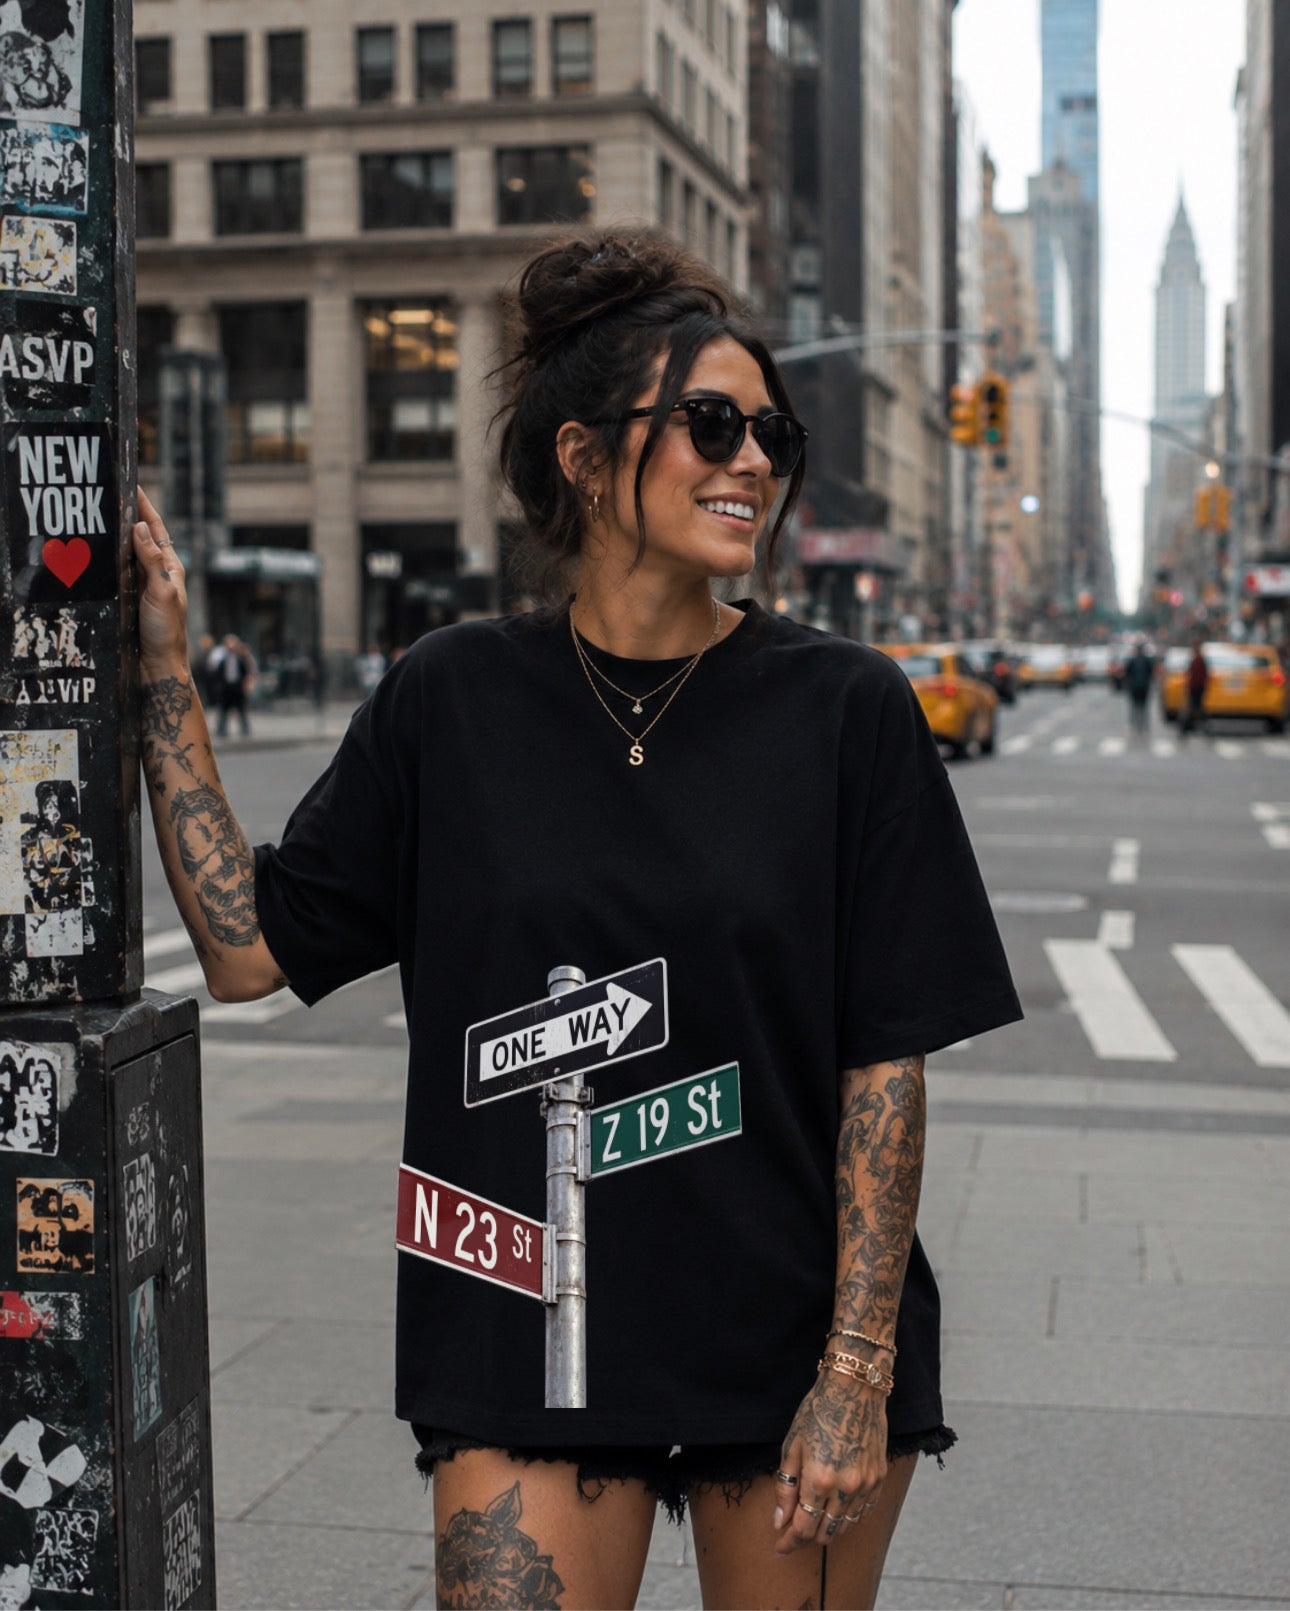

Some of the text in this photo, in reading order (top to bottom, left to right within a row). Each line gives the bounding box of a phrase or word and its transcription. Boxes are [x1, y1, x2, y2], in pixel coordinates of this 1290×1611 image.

[0, 334, 94, 384] ASVP
[18, 435, 100, 485] NEW
[20, 486, 107, 537] YORK
[629, 745, 644, 766] S
[492, 997, 631, 1071] ONE WAY
[602, 1080, 723, 1163] Z 19 St
[414, 1183, 532, 1270] N 23 St
